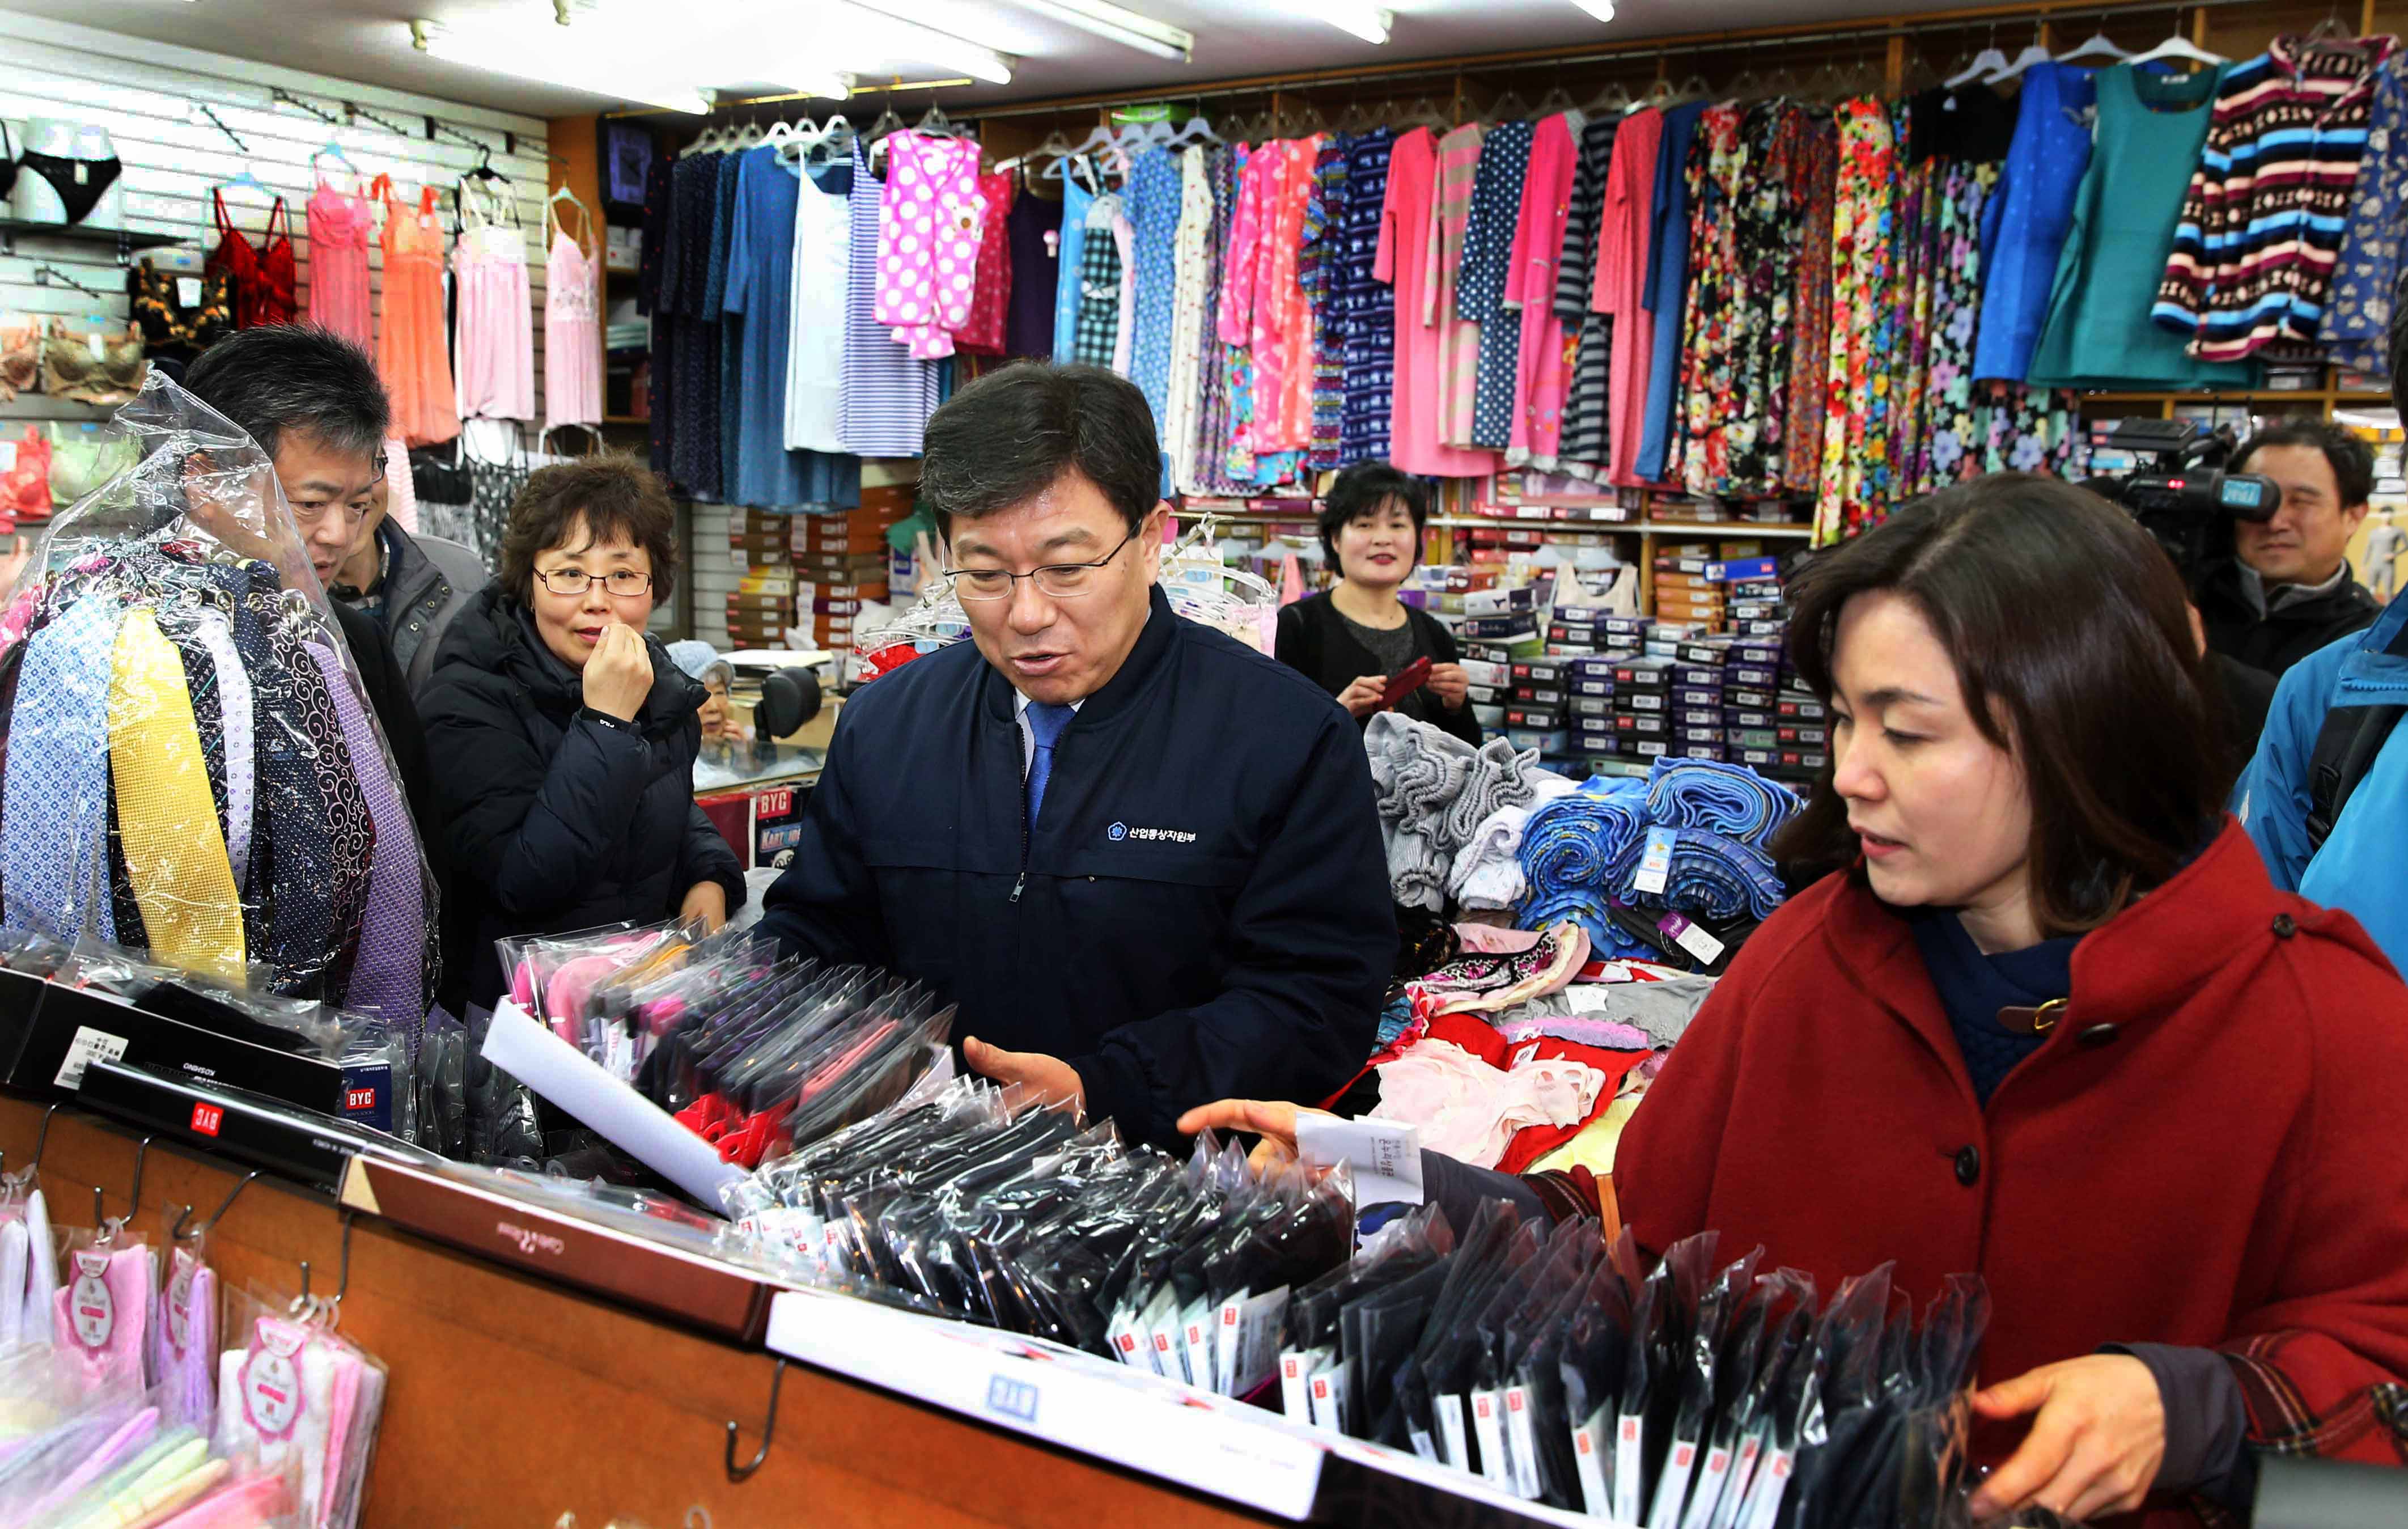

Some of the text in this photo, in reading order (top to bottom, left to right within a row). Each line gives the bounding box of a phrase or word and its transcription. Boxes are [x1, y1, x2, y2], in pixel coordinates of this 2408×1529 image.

[761, 791, 787, 814] BYC
[1129, 827, 1196, 842] 산업통상자원부
[183, 1062, 216, 1077] KOSHINO
[349, 1091, 372, 1106] BYC
[195, 1108, 219, 1131] BYC
